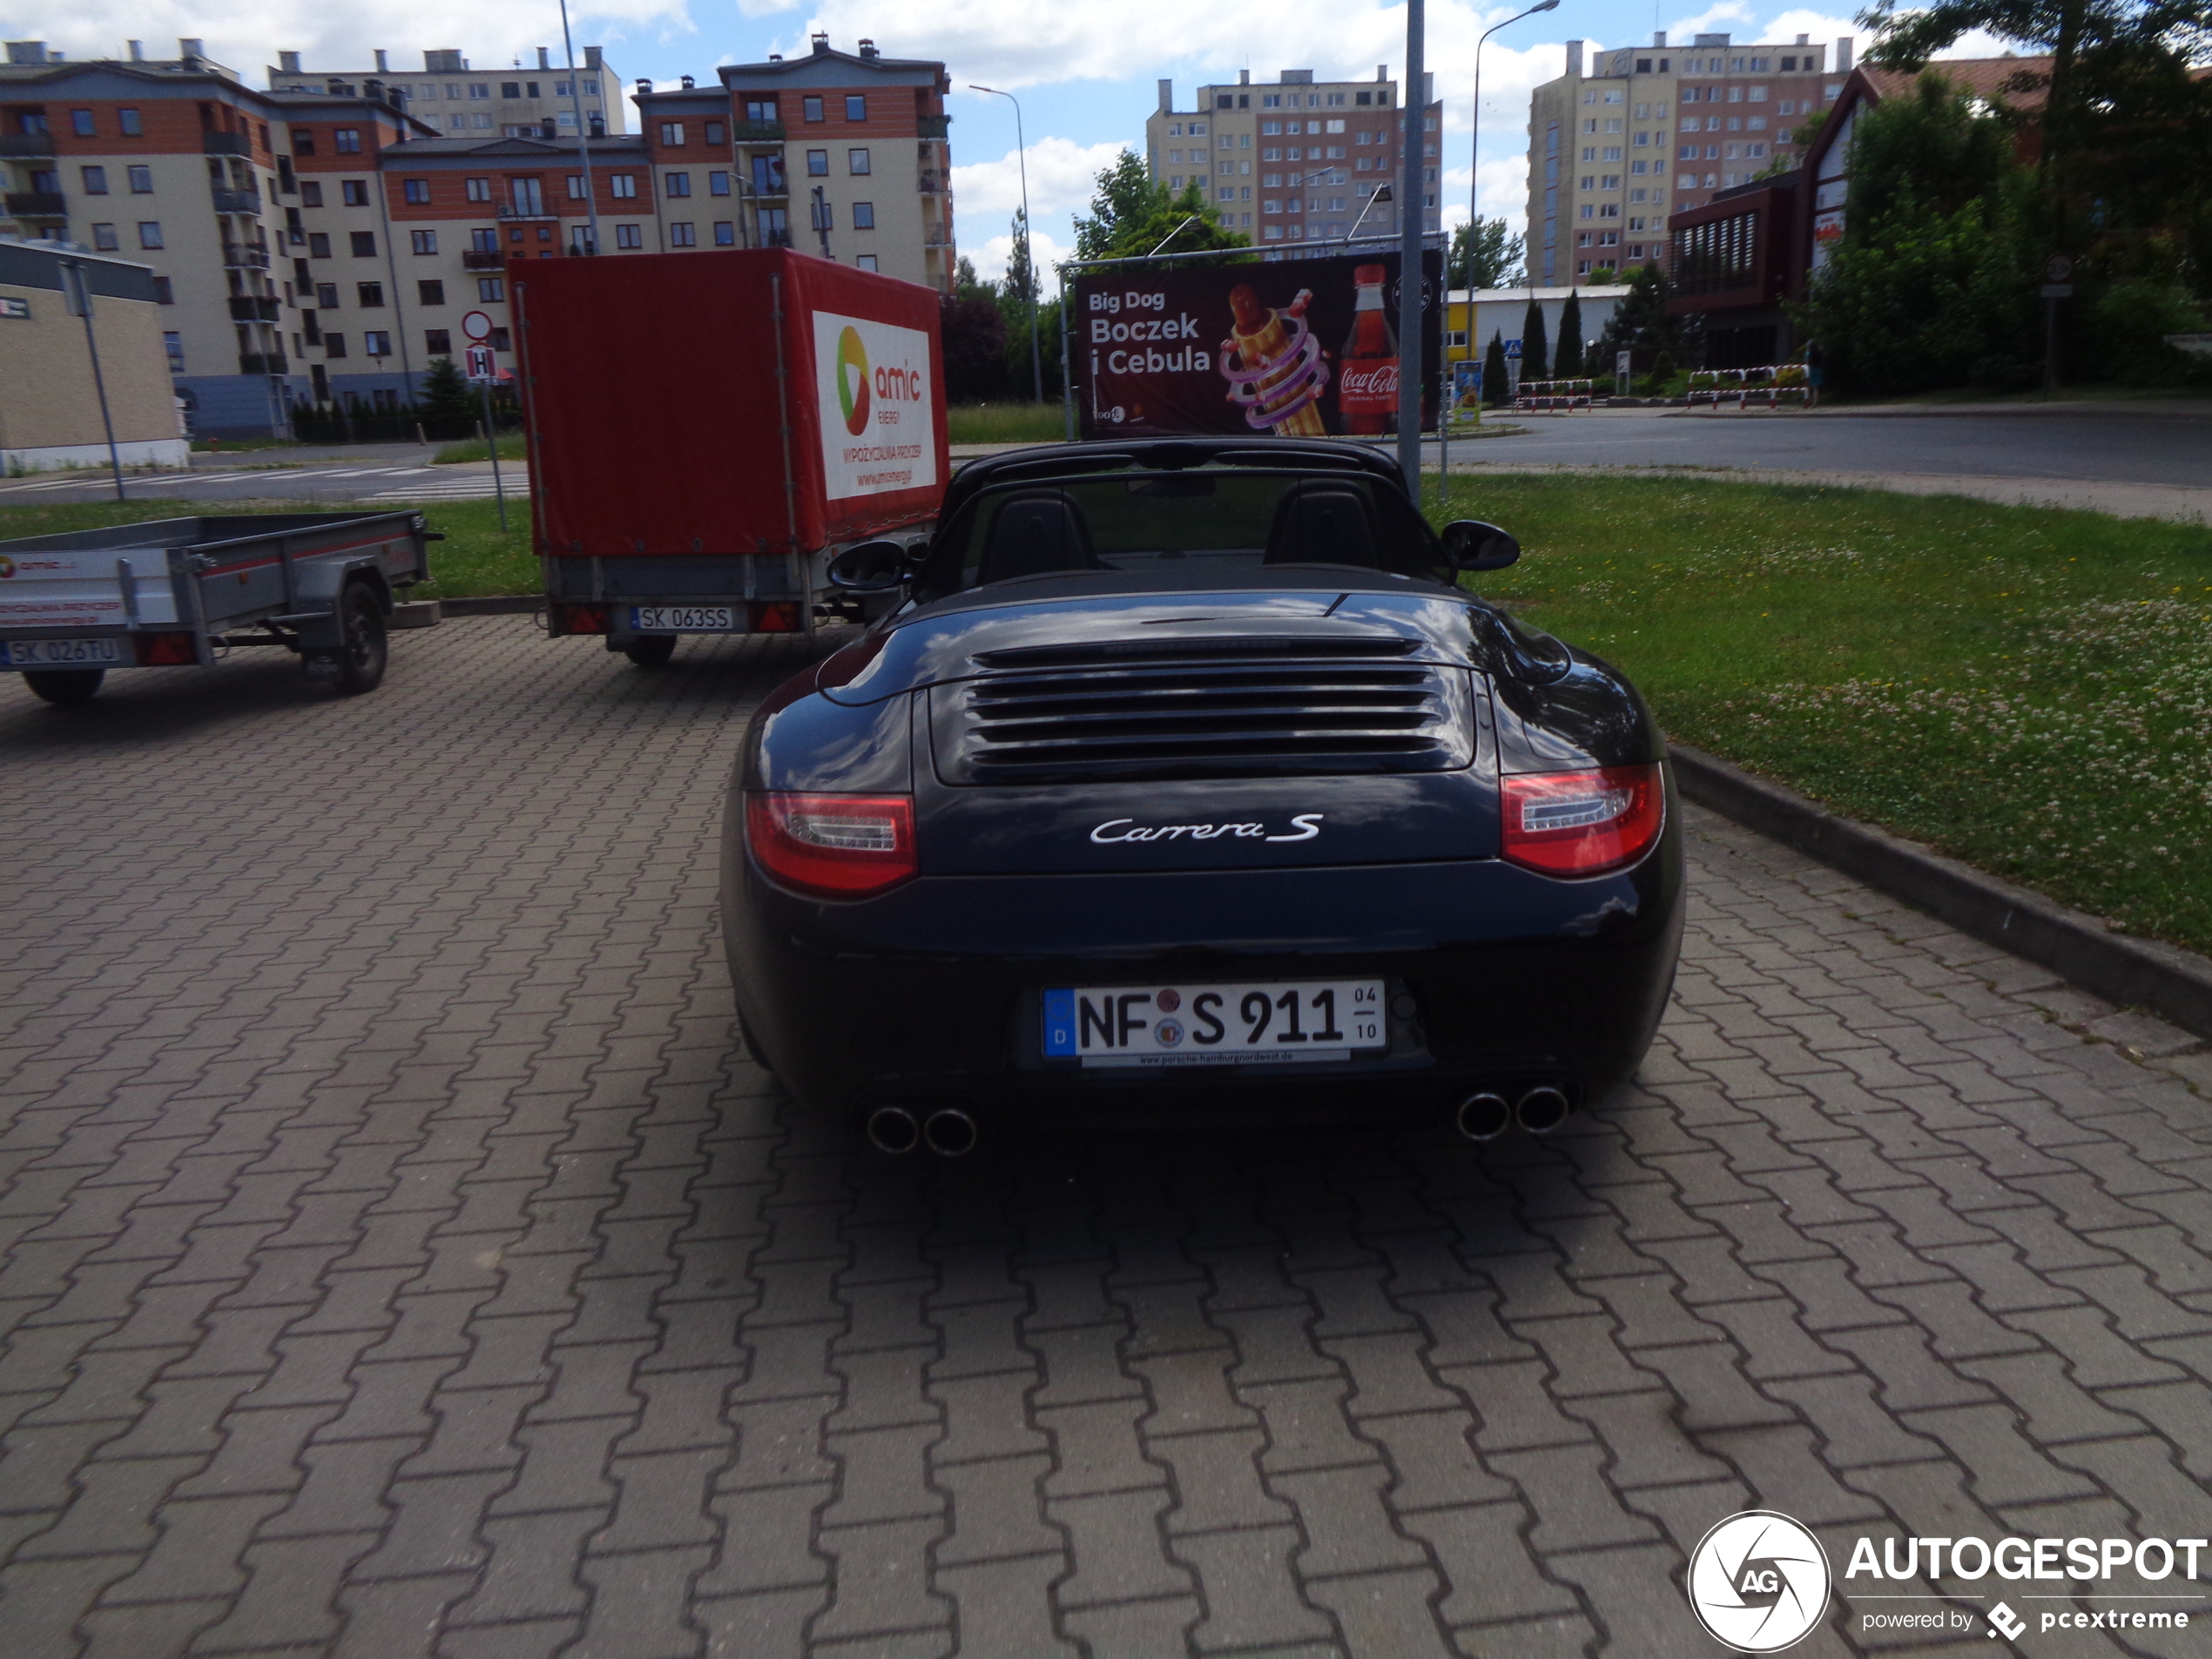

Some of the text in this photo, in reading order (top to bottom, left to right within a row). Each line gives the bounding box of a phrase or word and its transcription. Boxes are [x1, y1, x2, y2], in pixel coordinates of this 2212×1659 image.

[1089, 292, 1165, 314] Big Dog
[1091, 312, 1199, 343] Boczek
[475, 352, 488, 374] H
[1091, 346, 1210, 375] i Cebula
[875, 359, 921, 401] amic
[643, 609, 728, 627] SK 063SS
[12, 642, 42, 662] SK
[1090, 813, 1324, 843] Carrera S
[1354, 987, 1376, 1002] 04
[1080, 989, 1344, 1048] NF S 911
[1055, 1029, 1066, 1045] D
[1357, 1024, 1376, 1039] 10
